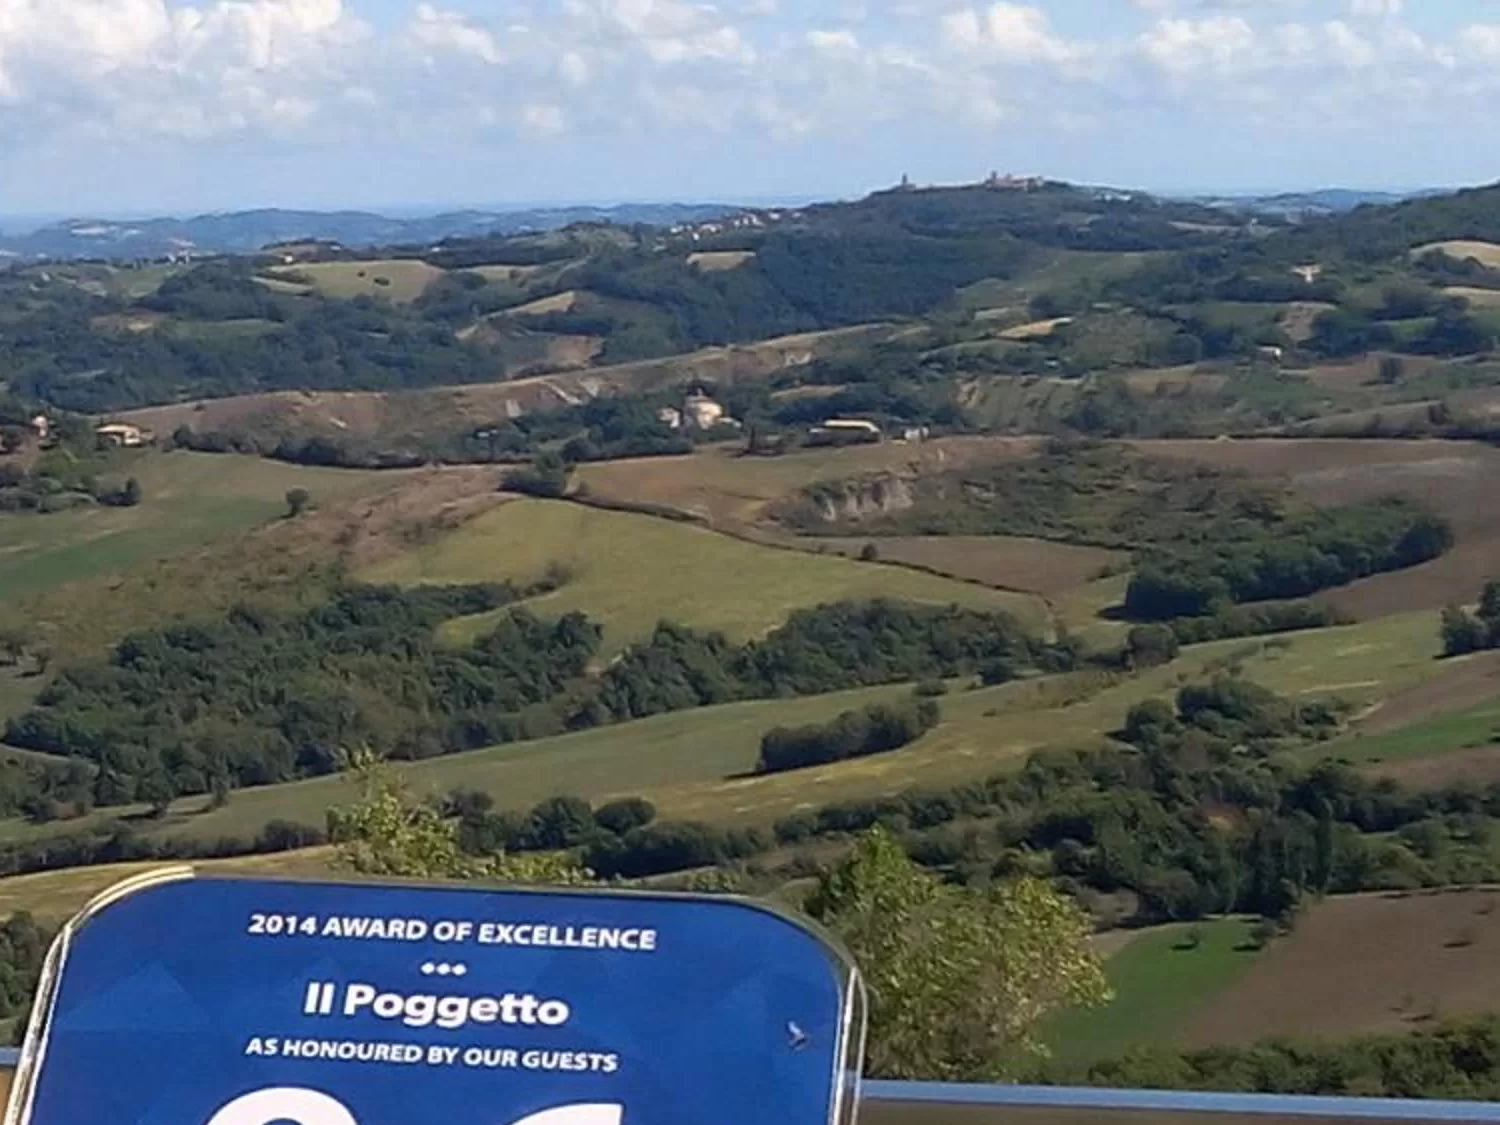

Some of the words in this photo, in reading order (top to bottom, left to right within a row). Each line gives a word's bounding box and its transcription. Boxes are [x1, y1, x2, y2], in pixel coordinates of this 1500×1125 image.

[248, 914, 317, 935] 2014
[321, 917, 427, 941] AWARD
[432, 921, 473, 943] OF
[477, 922, 658, 951] EXCELLENCE
[303, 981, 332, 1015] Il
[343, 984, 570, 1028] Poggetto
[245, 1037, 279, 1056] AS
[282, 1039, 423, 1064] HONOURED
[426, 1046, 460, 1065] BY
[463, 1048, 518, 1069] OUR
[521, 1051, 619, 1073] GUESTS
